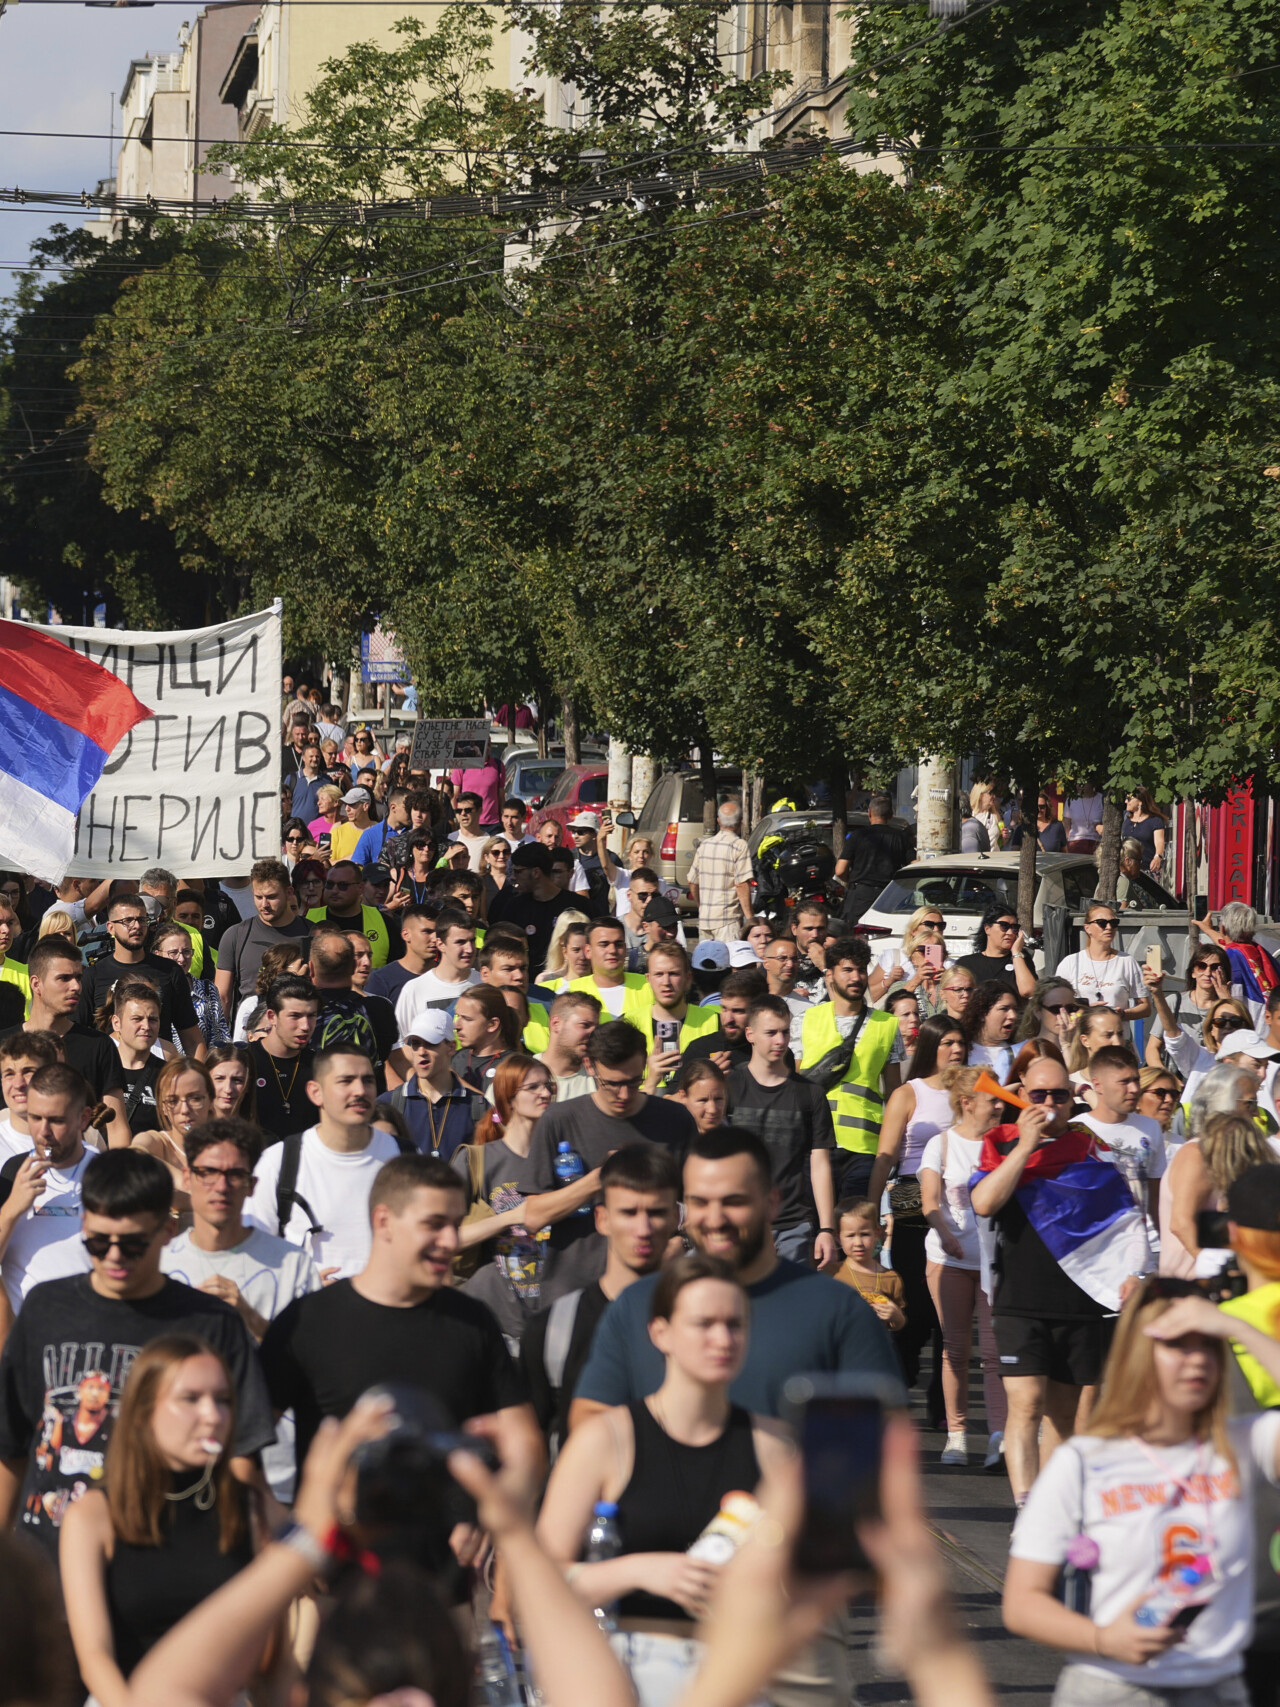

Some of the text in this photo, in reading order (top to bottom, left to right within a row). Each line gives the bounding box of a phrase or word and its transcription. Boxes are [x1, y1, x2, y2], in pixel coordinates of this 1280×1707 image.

[417, 731, 429, 740] СУ
[432, 730, 445, 740] СЕ
[1230, 853, 1245, 901] SAL
[1100, 1482, 1167, 1517] NEW
